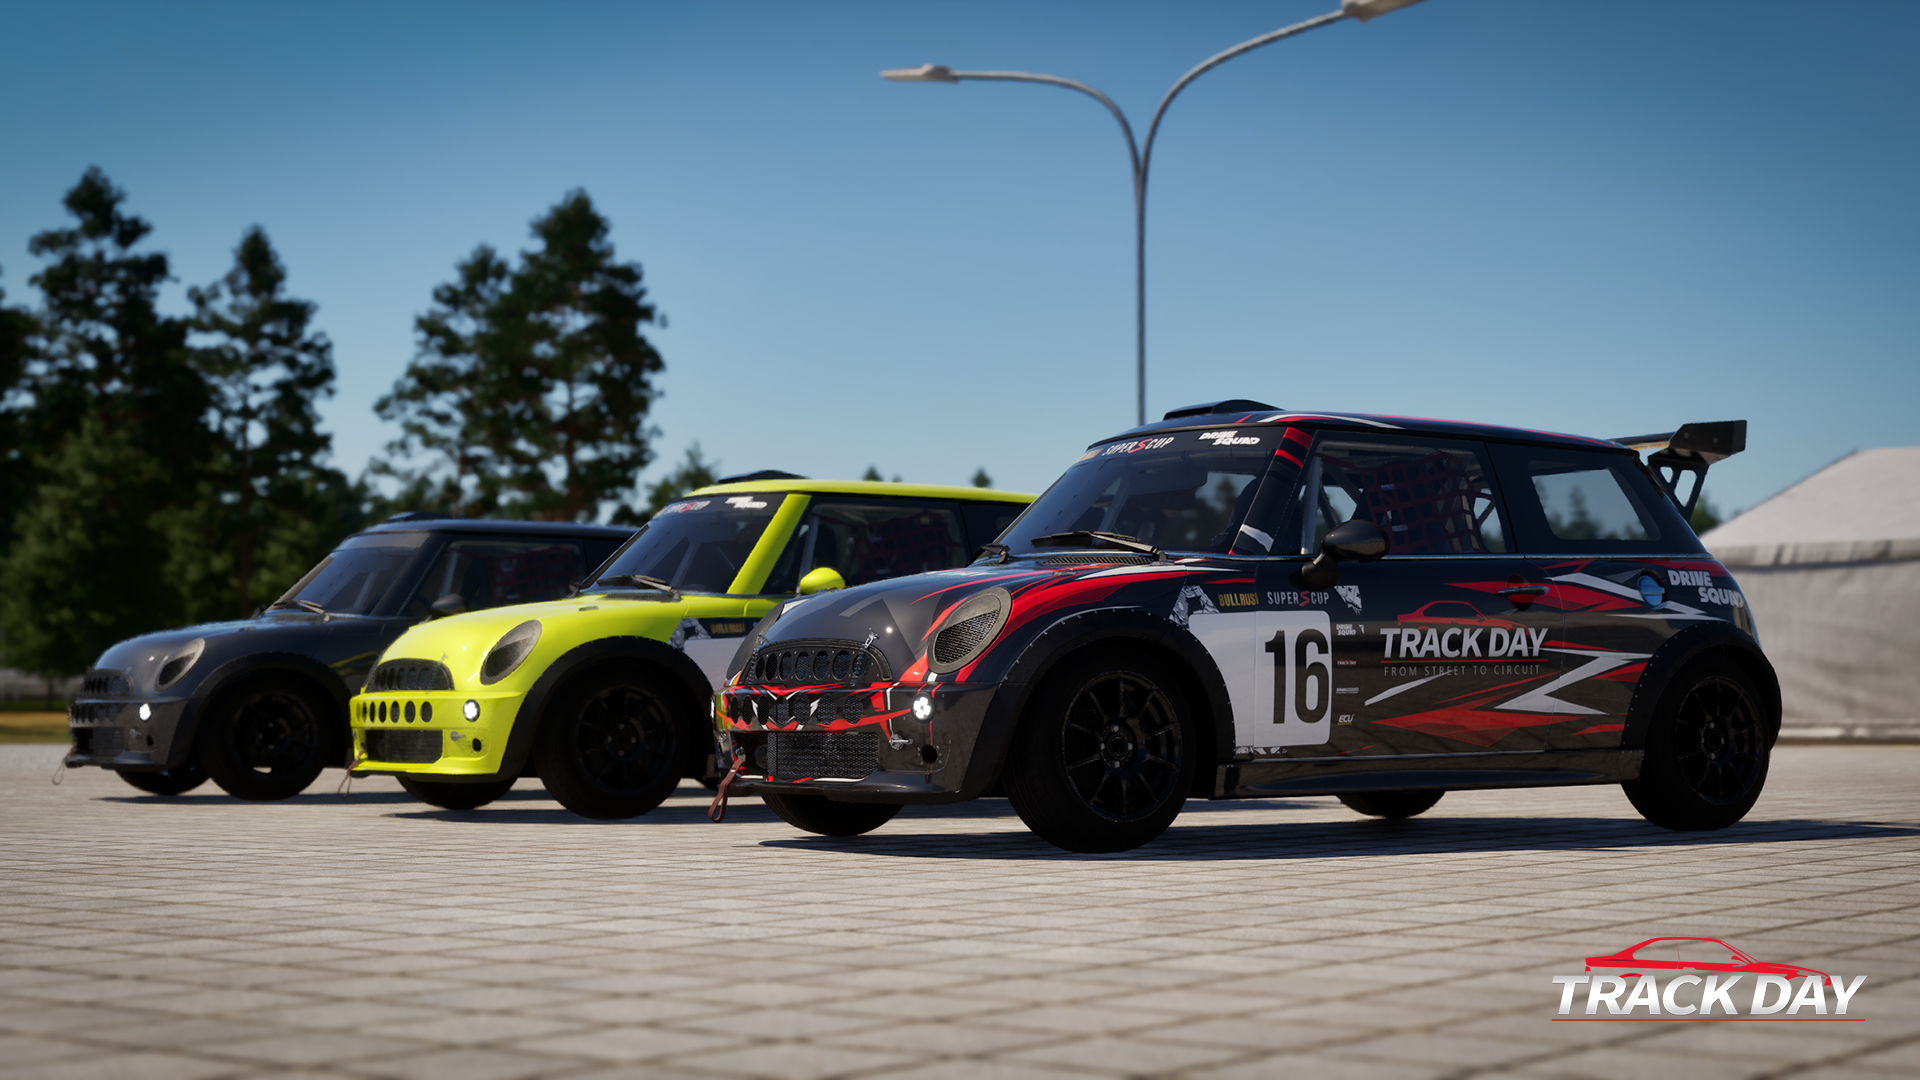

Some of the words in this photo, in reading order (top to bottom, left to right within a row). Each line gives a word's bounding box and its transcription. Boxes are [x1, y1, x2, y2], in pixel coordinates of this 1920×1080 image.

[1199, 430, 1239, 440] DRIVE
[1213, 437, 1261, 446] SQUAD
[1667, 570, 1714, 587] DRIVE
[1698, 587, 1744, 608] SQUAD
[1380, 627, 1484, 658] TRACK
[1488, 627, 1549, 658] DAY
[1265, 629, 1329, 725] 16
[1384, 666, 1417, 677] FROM
[1424, 665, 1466, 676] STREET
[1473, 665, 1488, 675] TO
[1493, 664, 1540, 675] CIRCUIT
